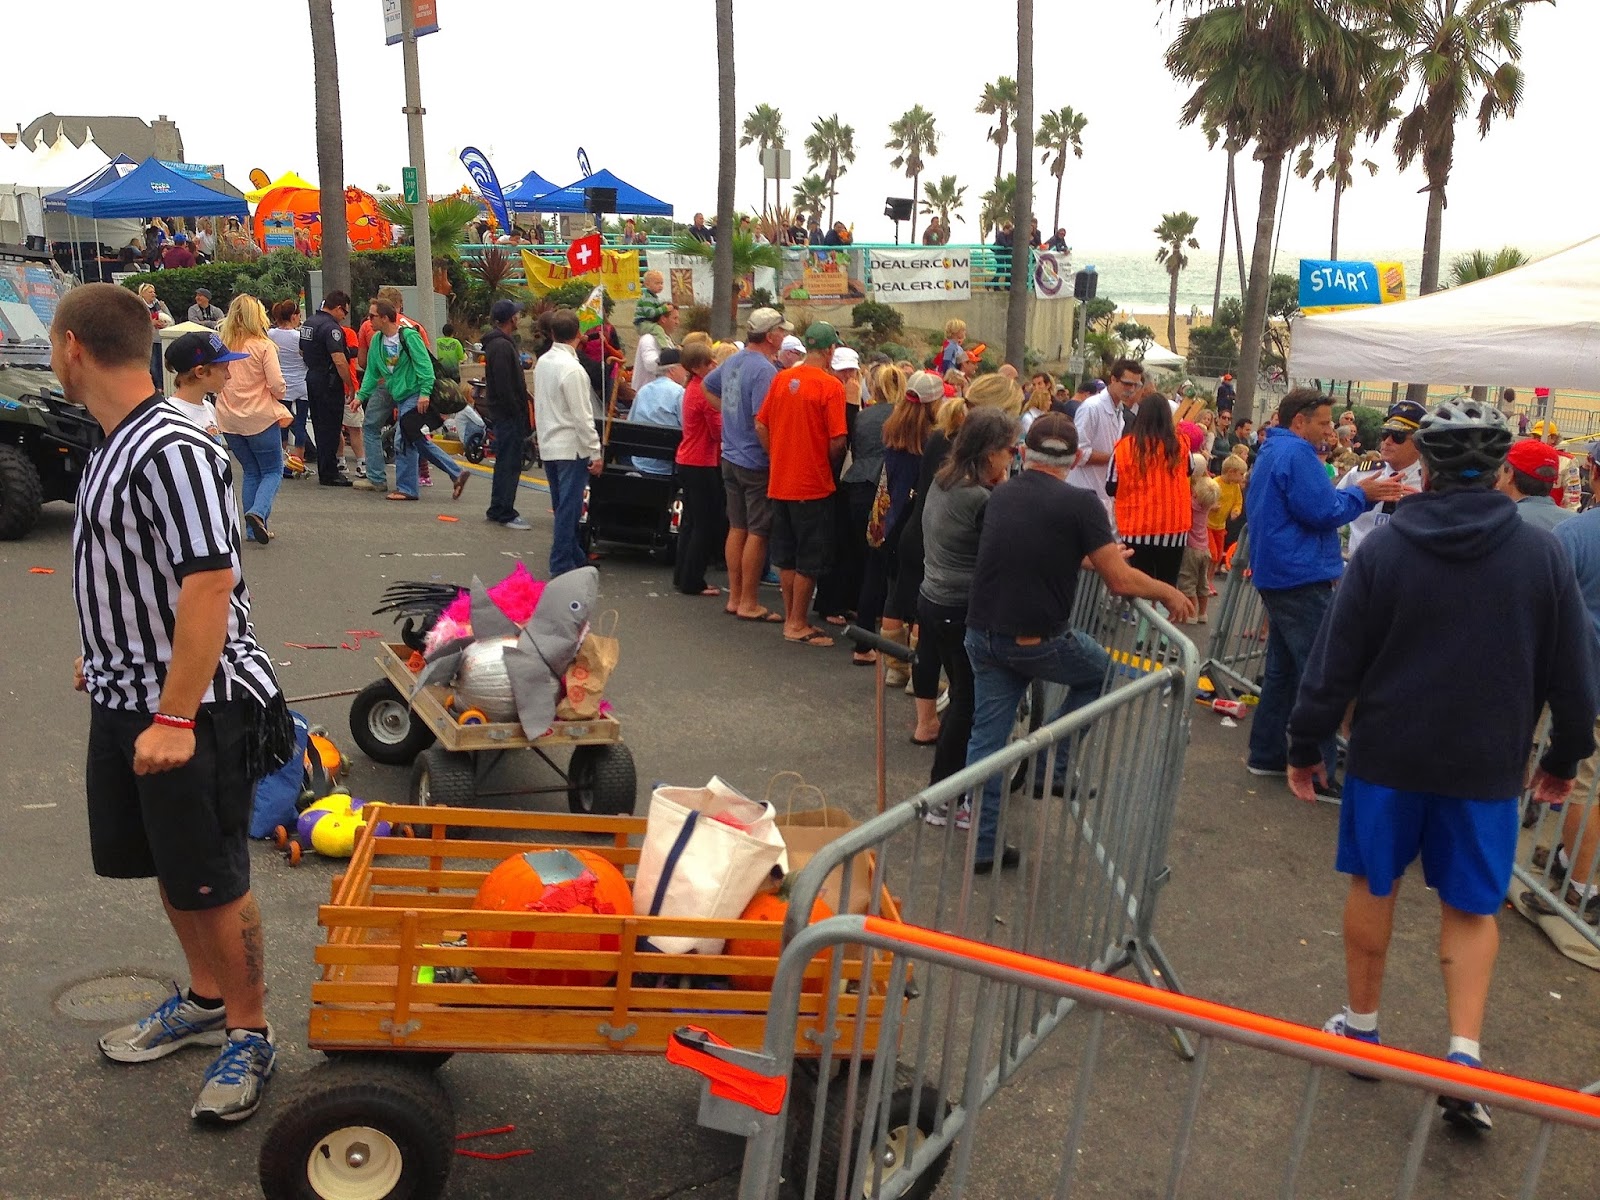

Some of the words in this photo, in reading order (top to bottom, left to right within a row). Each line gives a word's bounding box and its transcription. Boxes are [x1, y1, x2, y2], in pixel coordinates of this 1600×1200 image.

[405, 180, 416, 189] STOP
[870, 257, 969, 270] DEALER.COM
[1310, 267, 1369, 292] START
